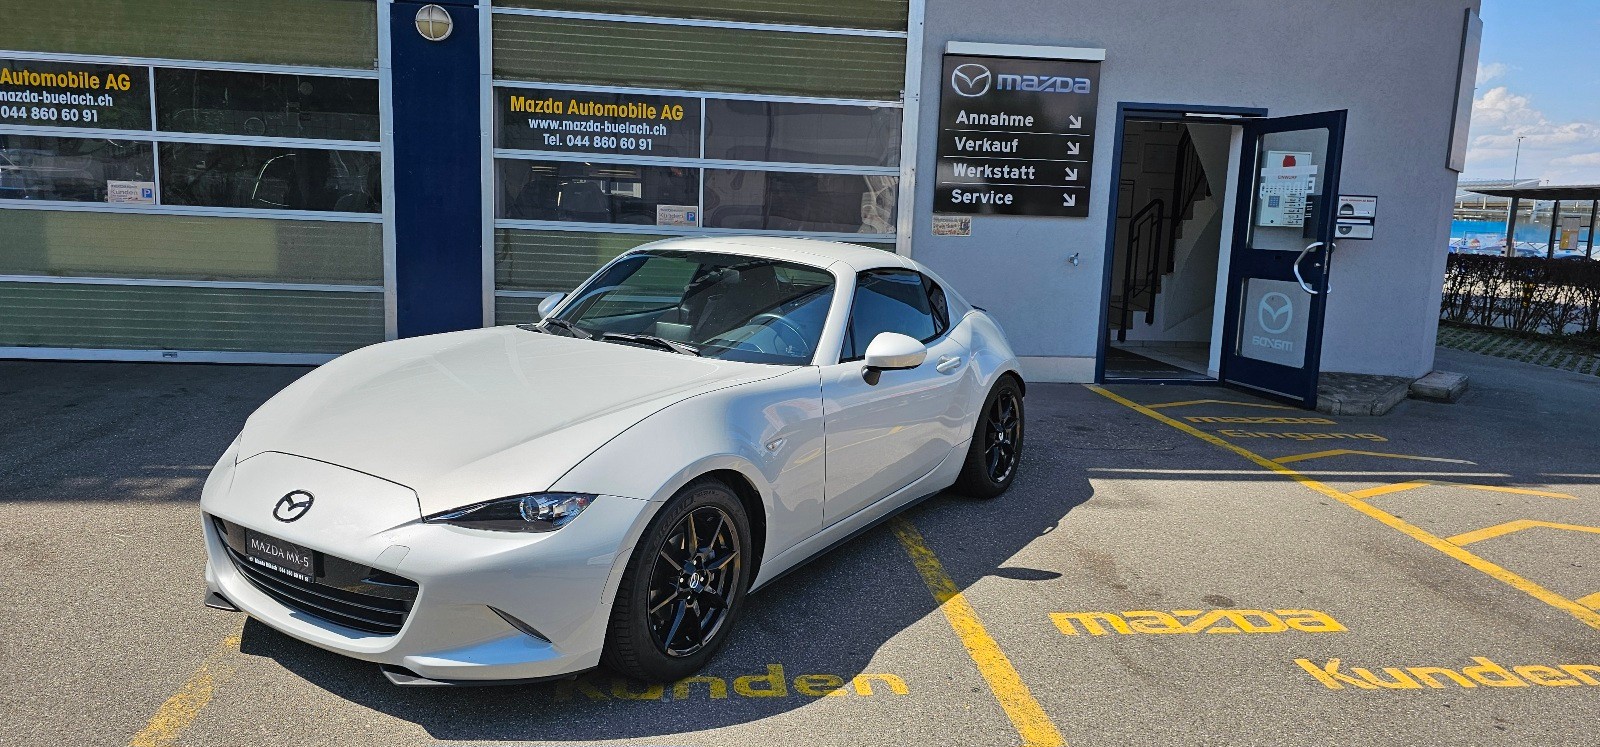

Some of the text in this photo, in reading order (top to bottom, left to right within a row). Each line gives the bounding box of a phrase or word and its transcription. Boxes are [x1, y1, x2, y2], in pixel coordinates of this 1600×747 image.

[0, 68, 131, 91] Automobile AG
[996, 74, 1091, 94] mazda
[0, 106, 98, 122] 044 860 60 91
[510, 96, 684, 121] Mazda Automobile AG
[528, 118, 667, 136] www.mazda-buelach.ch
[955, 110, 1034, 127] Annahme
[543, 133, 652, 150] Tel. 044 860 60 91
[955, 136, 1018, 153] Verkauf
[953, 162, 1036, 180] Werkstatt
[951, 190, 1014, 205] Service
[1184, 416, 1338, 425] mazda
[1218, 429, 1389, 442] Eingang
[251, 538, 309, 567] MAZDA MX-5
[1048, 609, 1349, 636] mazda
[1294, 656, 1600, 690] Kunden
